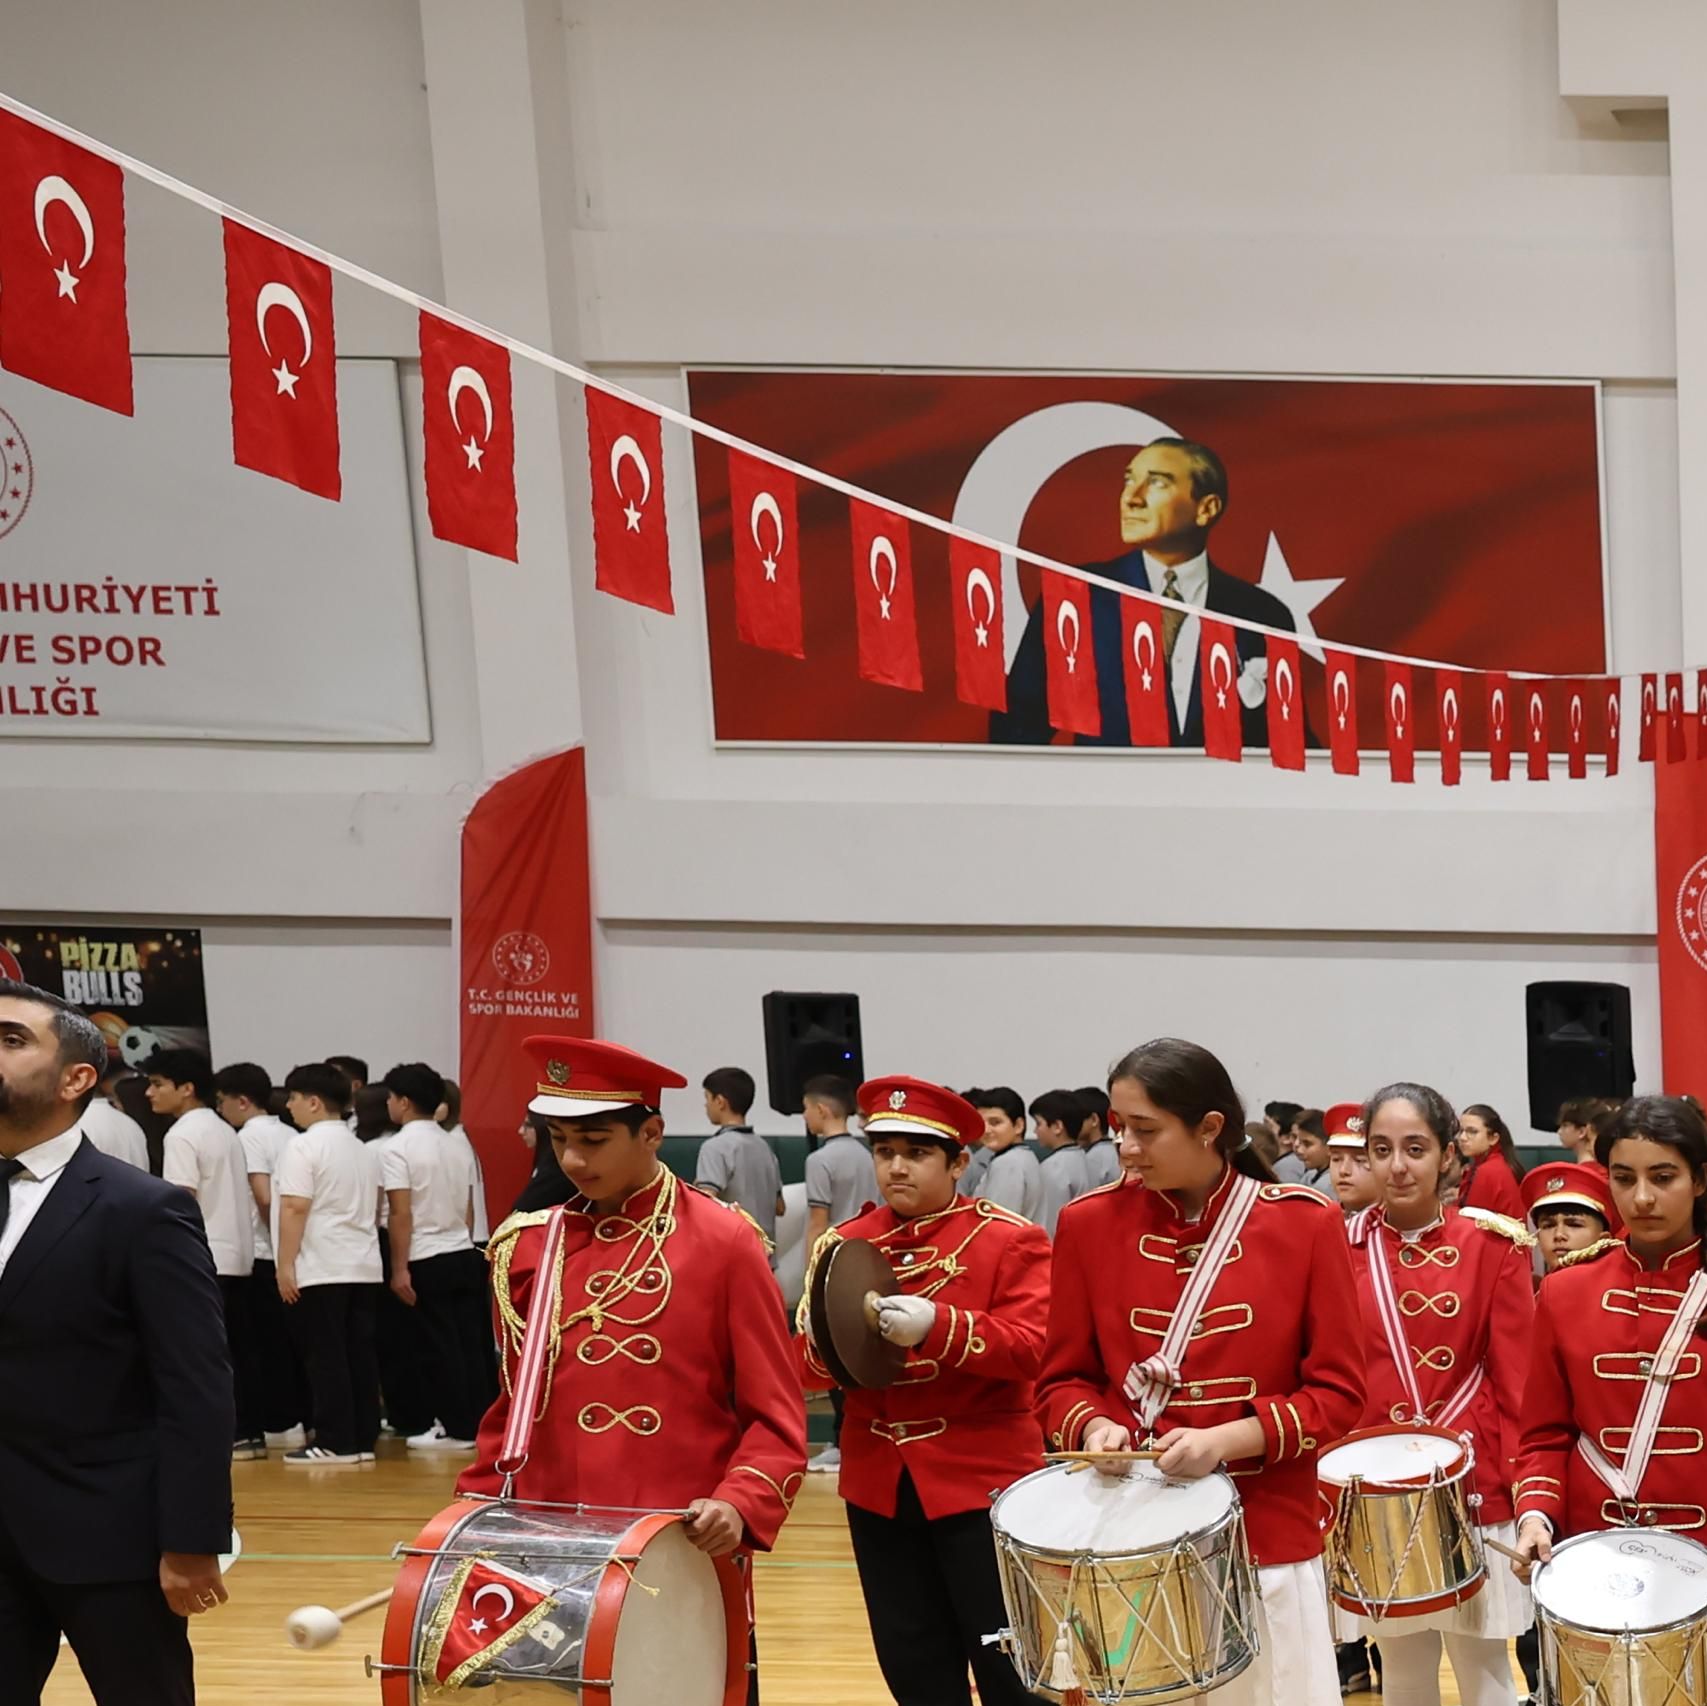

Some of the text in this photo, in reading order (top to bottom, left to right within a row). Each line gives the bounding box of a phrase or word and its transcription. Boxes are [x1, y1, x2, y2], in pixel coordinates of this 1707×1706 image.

[0, 575, 220, 616] HURİYETİ
[51, 634, 166, 667] SPOR
[0, 676, 100, 717] LIĞI
[62, 969, 144, 1007] BULLS
[468, 988, 578, 1005] T.C. GENÇLİK VE
[468, 1003, 580, 1019] SPOR BAKANLIĞI
